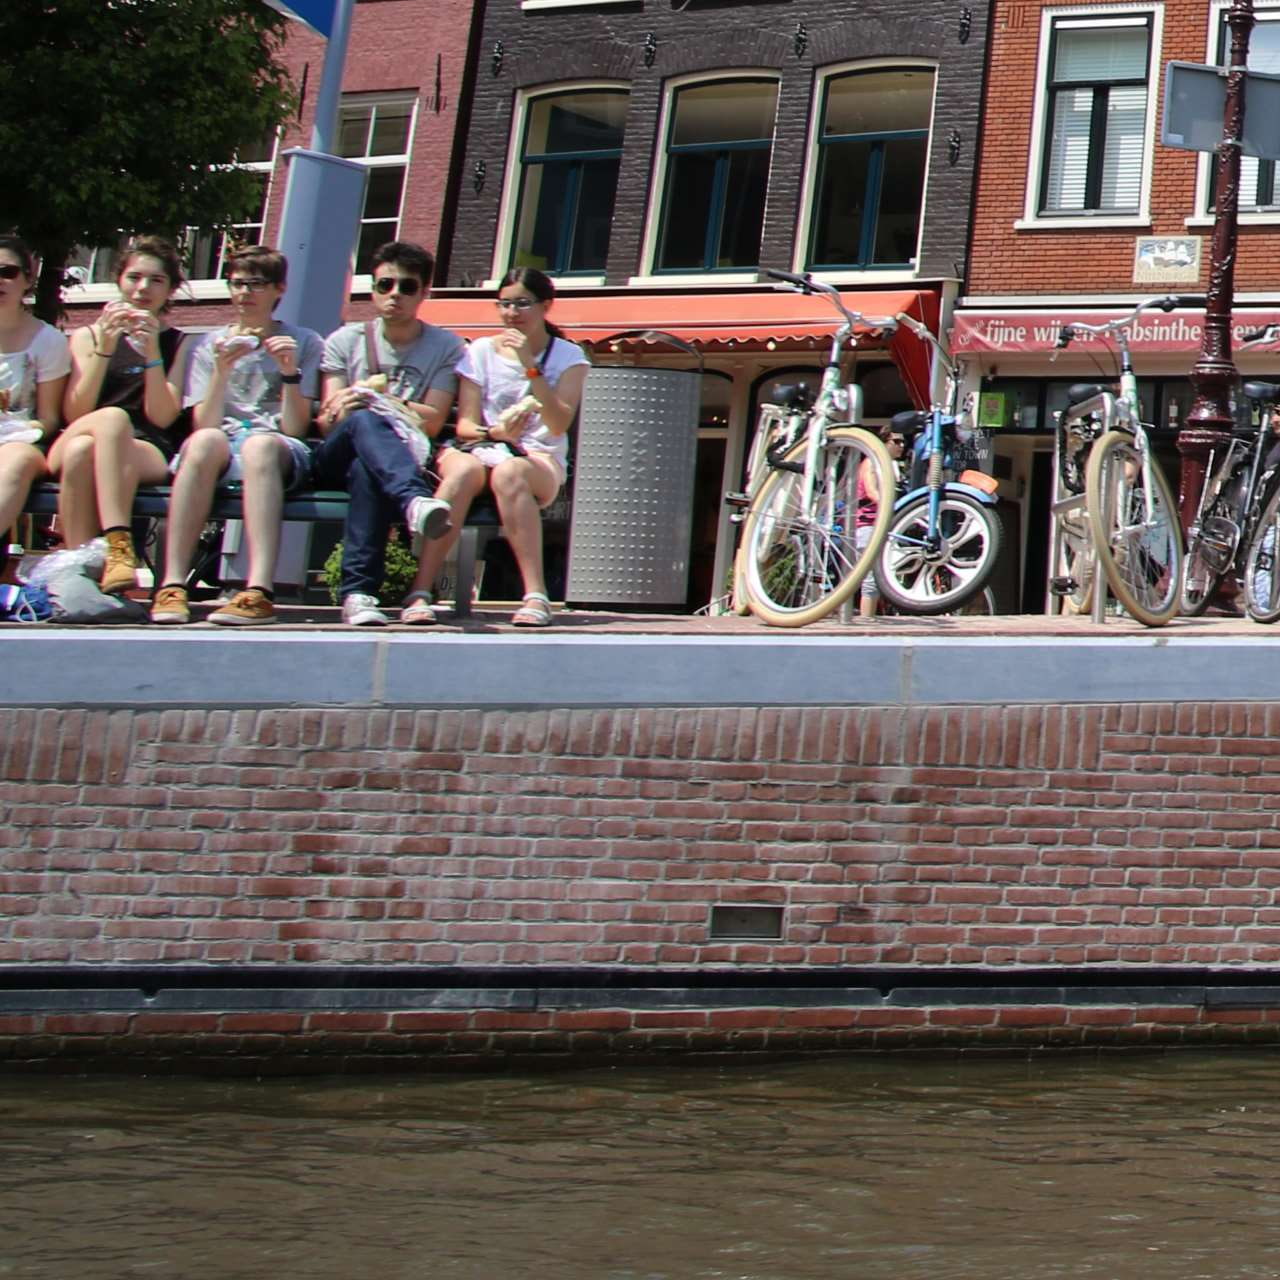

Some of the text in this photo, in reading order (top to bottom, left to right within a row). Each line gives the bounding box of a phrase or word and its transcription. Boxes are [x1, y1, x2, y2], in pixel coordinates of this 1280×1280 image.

[986, 321, 1026, 347] fijne
[1034, 319, 1095, 347] wijen
[1121, 319, 1201, 342] absinthe
